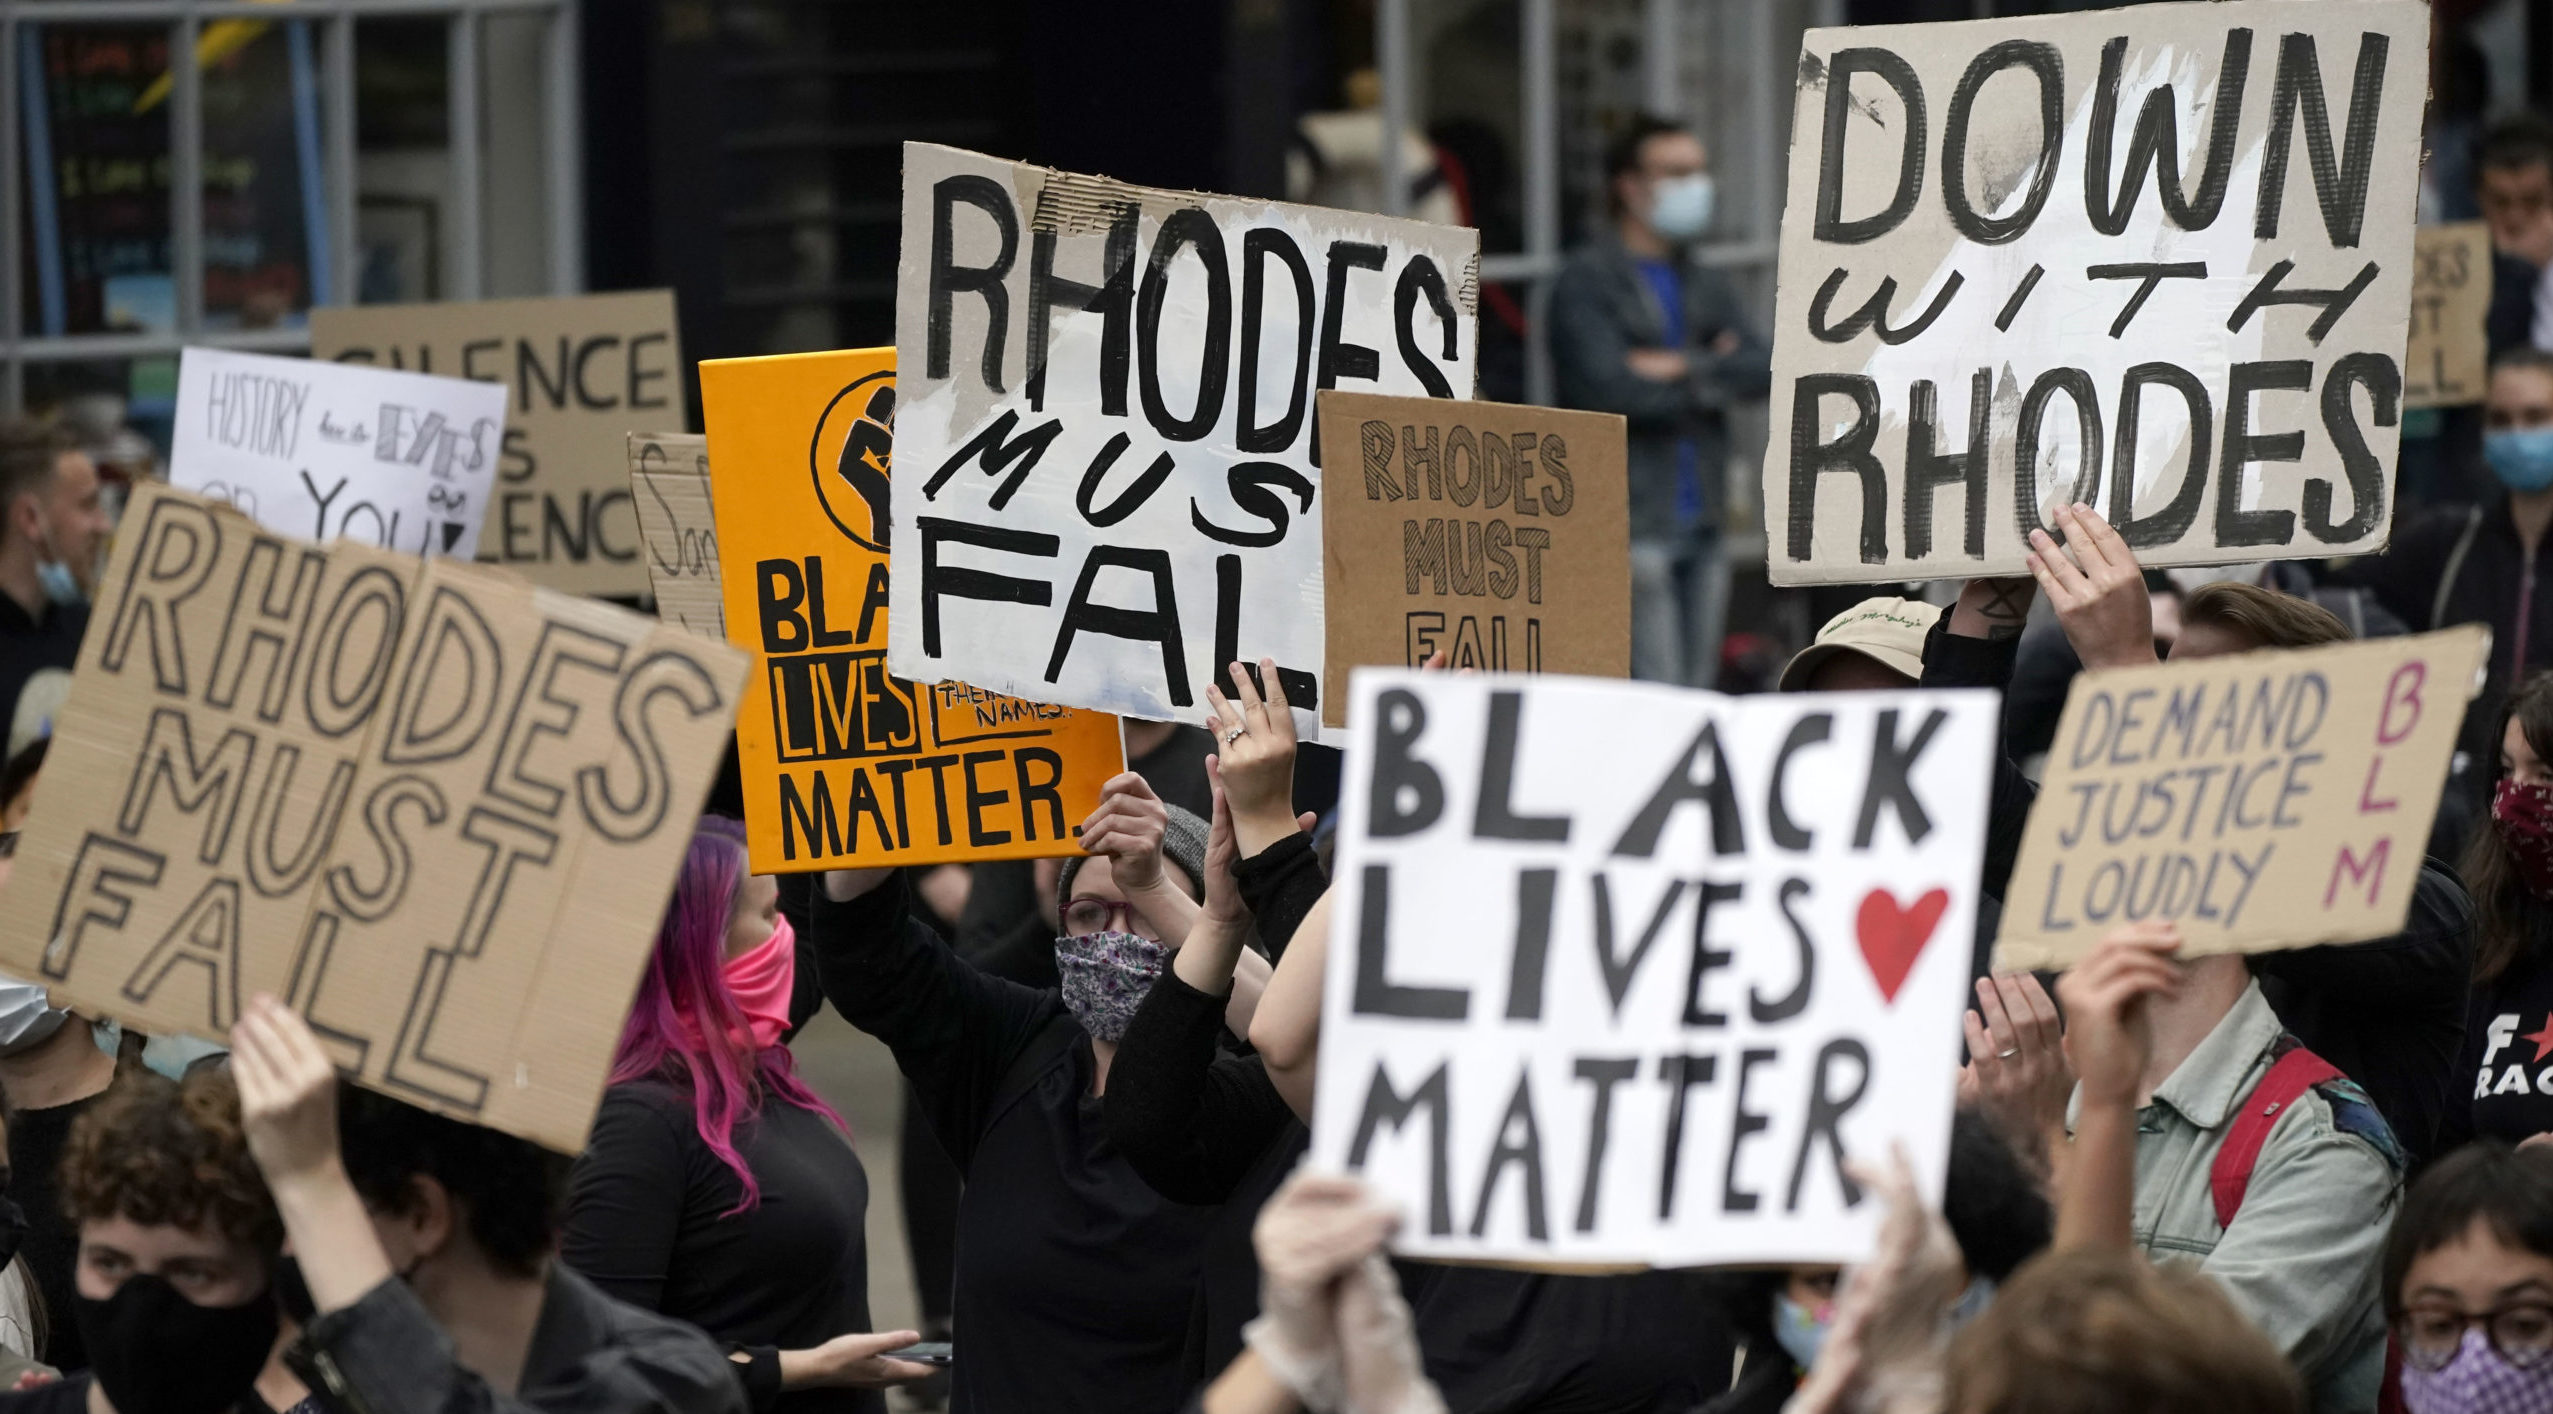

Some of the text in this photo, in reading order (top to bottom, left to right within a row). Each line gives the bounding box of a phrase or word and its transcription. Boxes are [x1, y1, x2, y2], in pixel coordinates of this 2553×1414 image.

[1813, 27, 2391, 249] DOWN
[926, 174, 1459, 468] RHODES
[1807, 259, 2381, 348] WITH
[207, 371, 311, 460] HISTORY
[374, 402, 497, 480] EYES
[922, 408, 1316, 549] MUS
[1360, 420, 1574, 517] RHODES
[1787, 351, 2401, 566] RHODES
[755, 555, 890, 653] BLA
[916, 515, 1318, 711] FAL
[1404, 518, 1550, 604] MUST
[102, 499, 722, 845] RHODES
[772, 654, 918, 759] LIVES
[2070, 670, 2329, 771] DEMAND
[118, 706, 559, 957] MUST
[1367, 689, 1953, 859] BLACK
[2057, 753, 2325, 848] JUSTICE
[1352, 864, 1816, 1027] LIVES
[2039, 843, 2276, 932] LOUDLY
[40, 832, 489, 1111] FALL
[1347, 1037, 1873, 1244] MATTER
